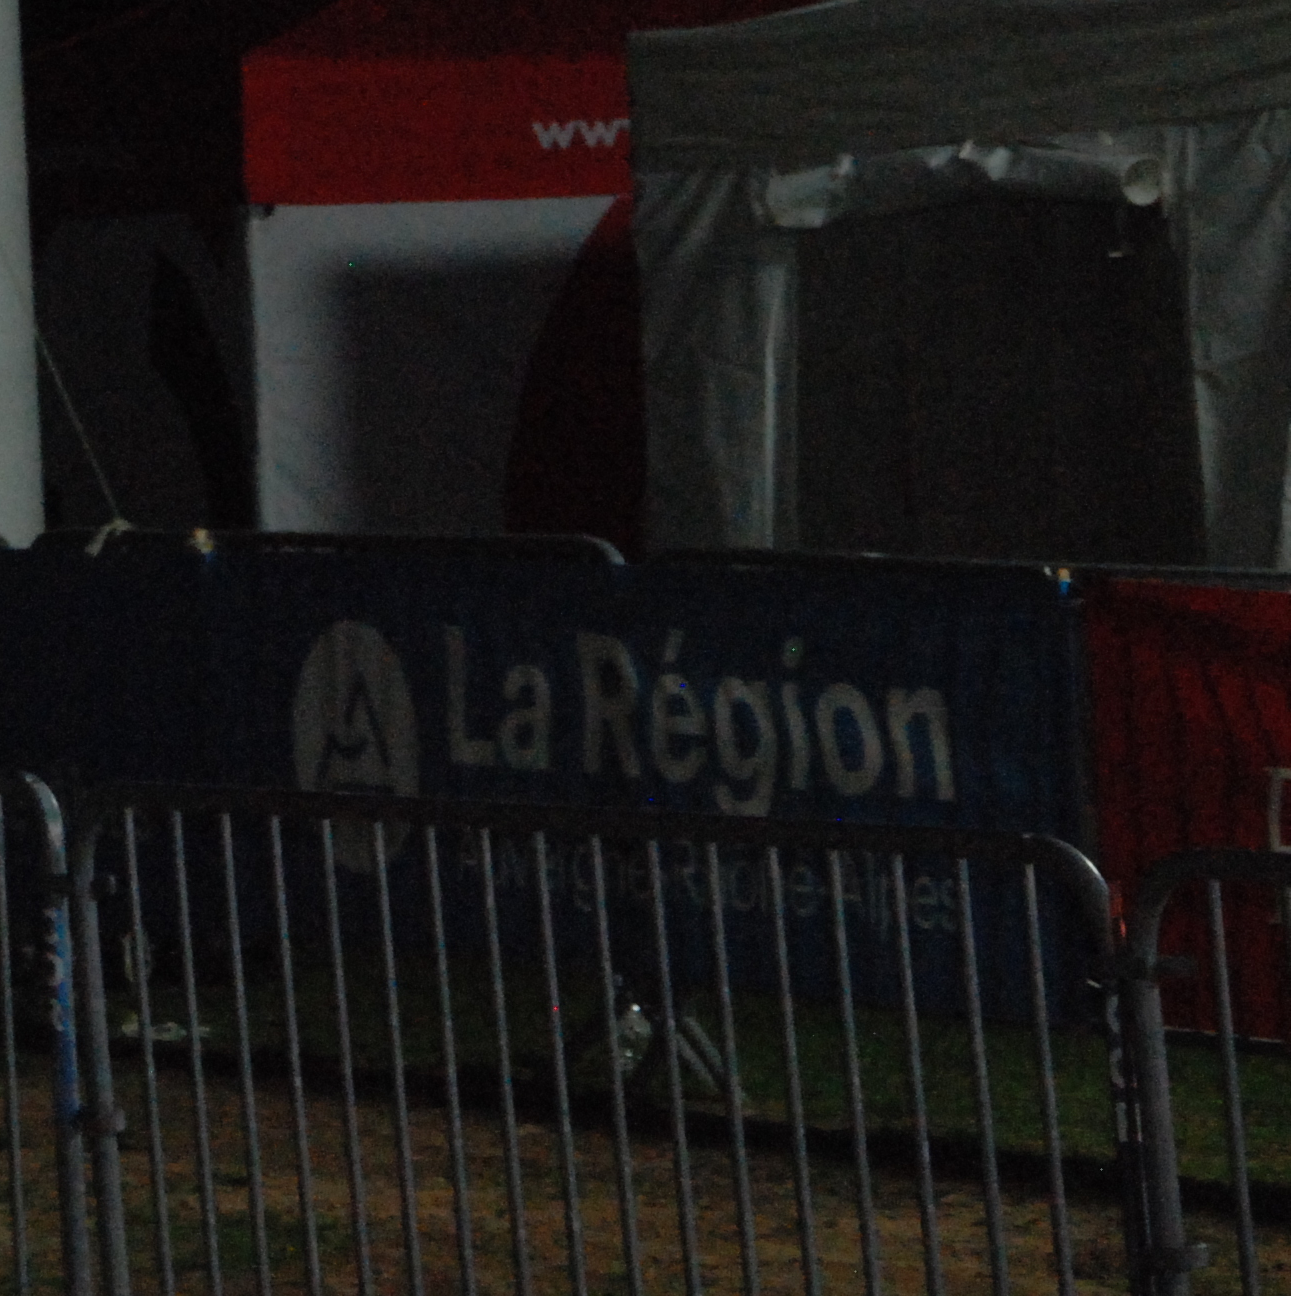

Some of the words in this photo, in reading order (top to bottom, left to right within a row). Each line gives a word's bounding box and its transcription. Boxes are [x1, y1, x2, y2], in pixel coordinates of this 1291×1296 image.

[531, 117, 632, 150] ww
[444, 624, 552, 771] La
[576, 628, 956, 817] Région
